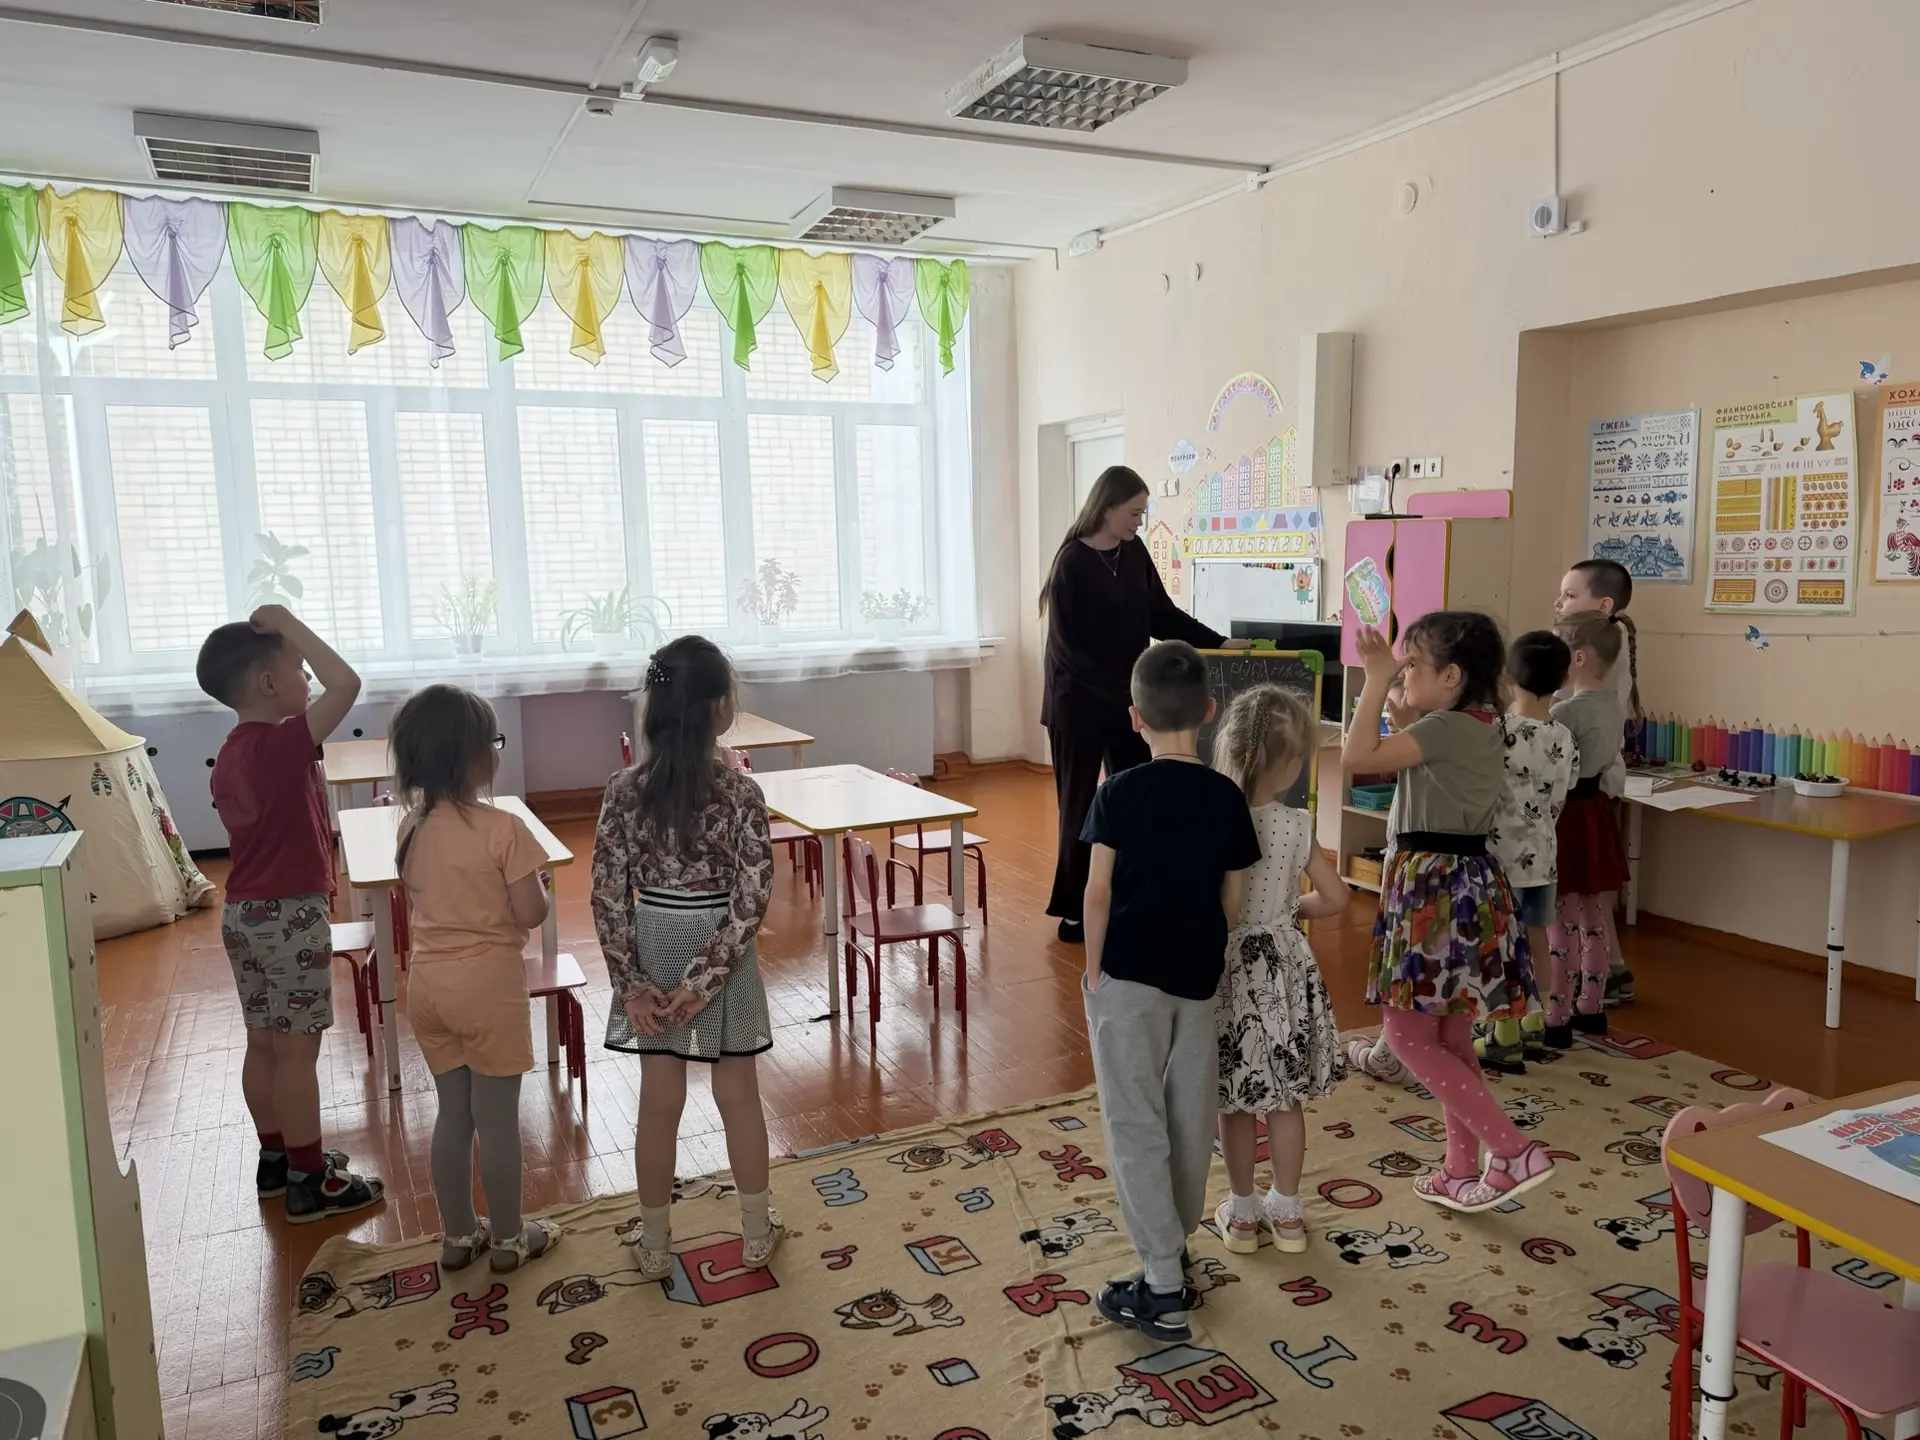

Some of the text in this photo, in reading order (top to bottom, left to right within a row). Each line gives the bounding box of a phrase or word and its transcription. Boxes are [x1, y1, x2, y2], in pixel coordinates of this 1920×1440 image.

[1716, 399, 1794, 415] ФИЛИМОНОВСКАЯ
[1715, 411, 1772, 424] СВИСТУЛЬКА
[1600, 420, 1630, 431] ГЖЕЛЬ
